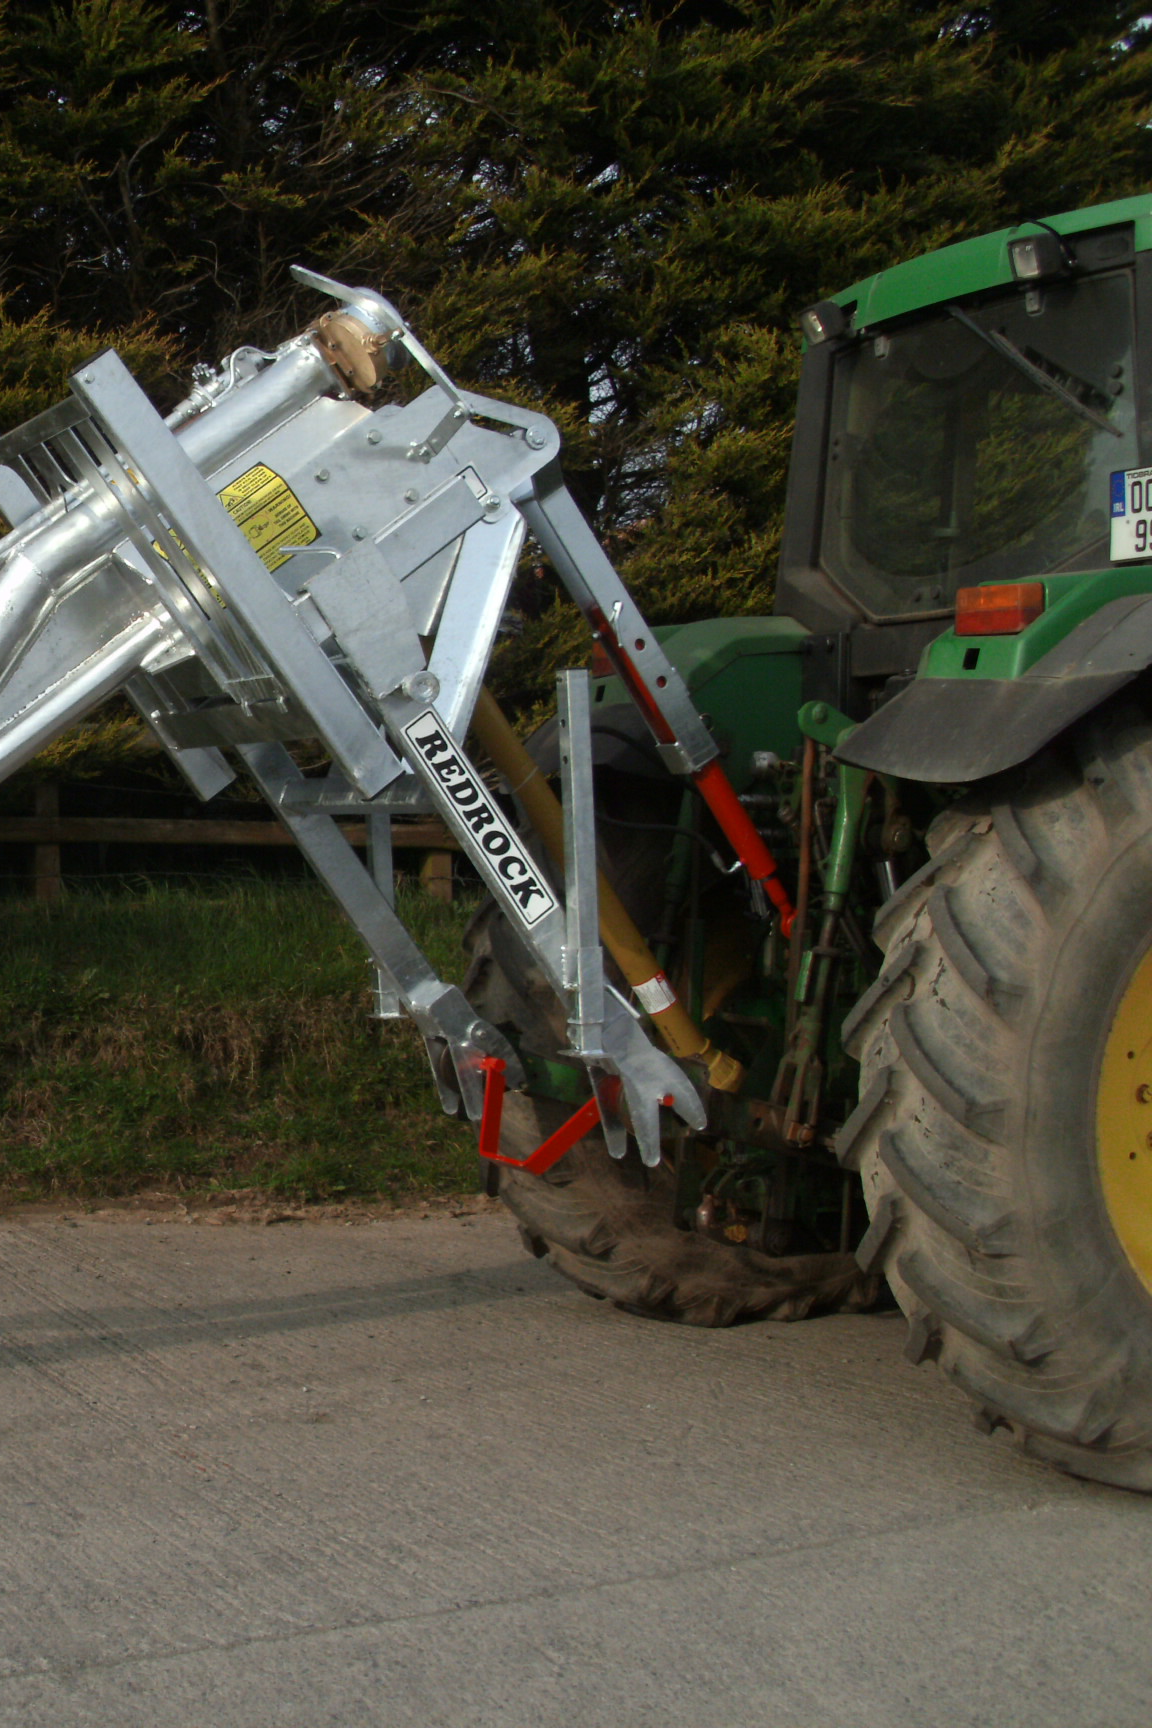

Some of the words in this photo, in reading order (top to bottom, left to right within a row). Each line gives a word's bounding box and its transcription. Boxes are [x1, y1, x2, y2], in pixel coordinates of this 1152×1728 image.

[1113, 502, 1124, 513] IRL
[1135, 520, 1152, 552] 9
[415, 730, 545, 909] REDROCK
